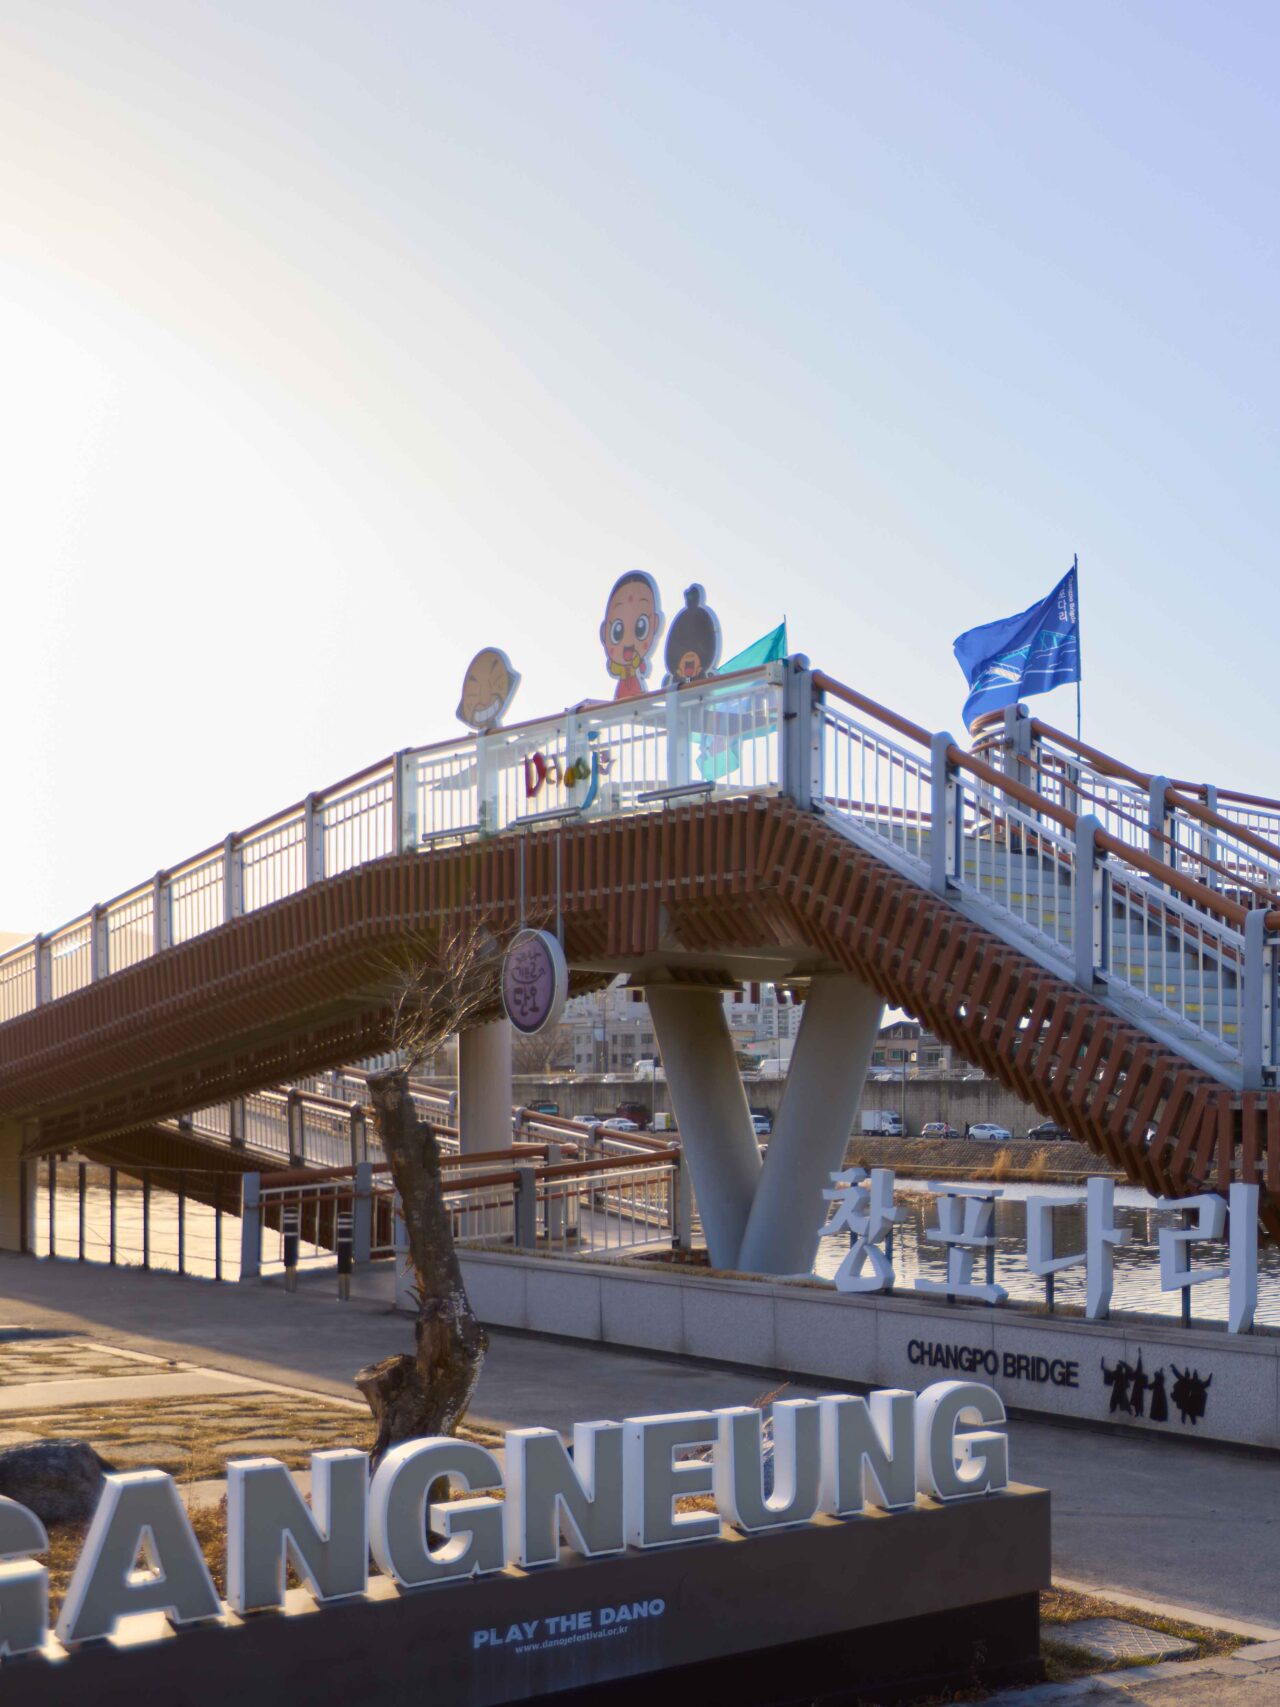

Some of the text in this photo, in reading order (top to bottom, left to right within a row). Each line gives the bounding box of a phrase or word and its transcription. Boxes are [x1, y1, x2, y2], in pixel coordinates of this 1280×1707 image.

[817, 1166, 1260, 1335] 창포다리
[907, 1339, 1079, 1388] CHANGPO BRIDGE
[473, 1598, 665, 1649] PLAY THE DANO
[514, 1626, 629, 1654] www.danojefestival.or.kr
